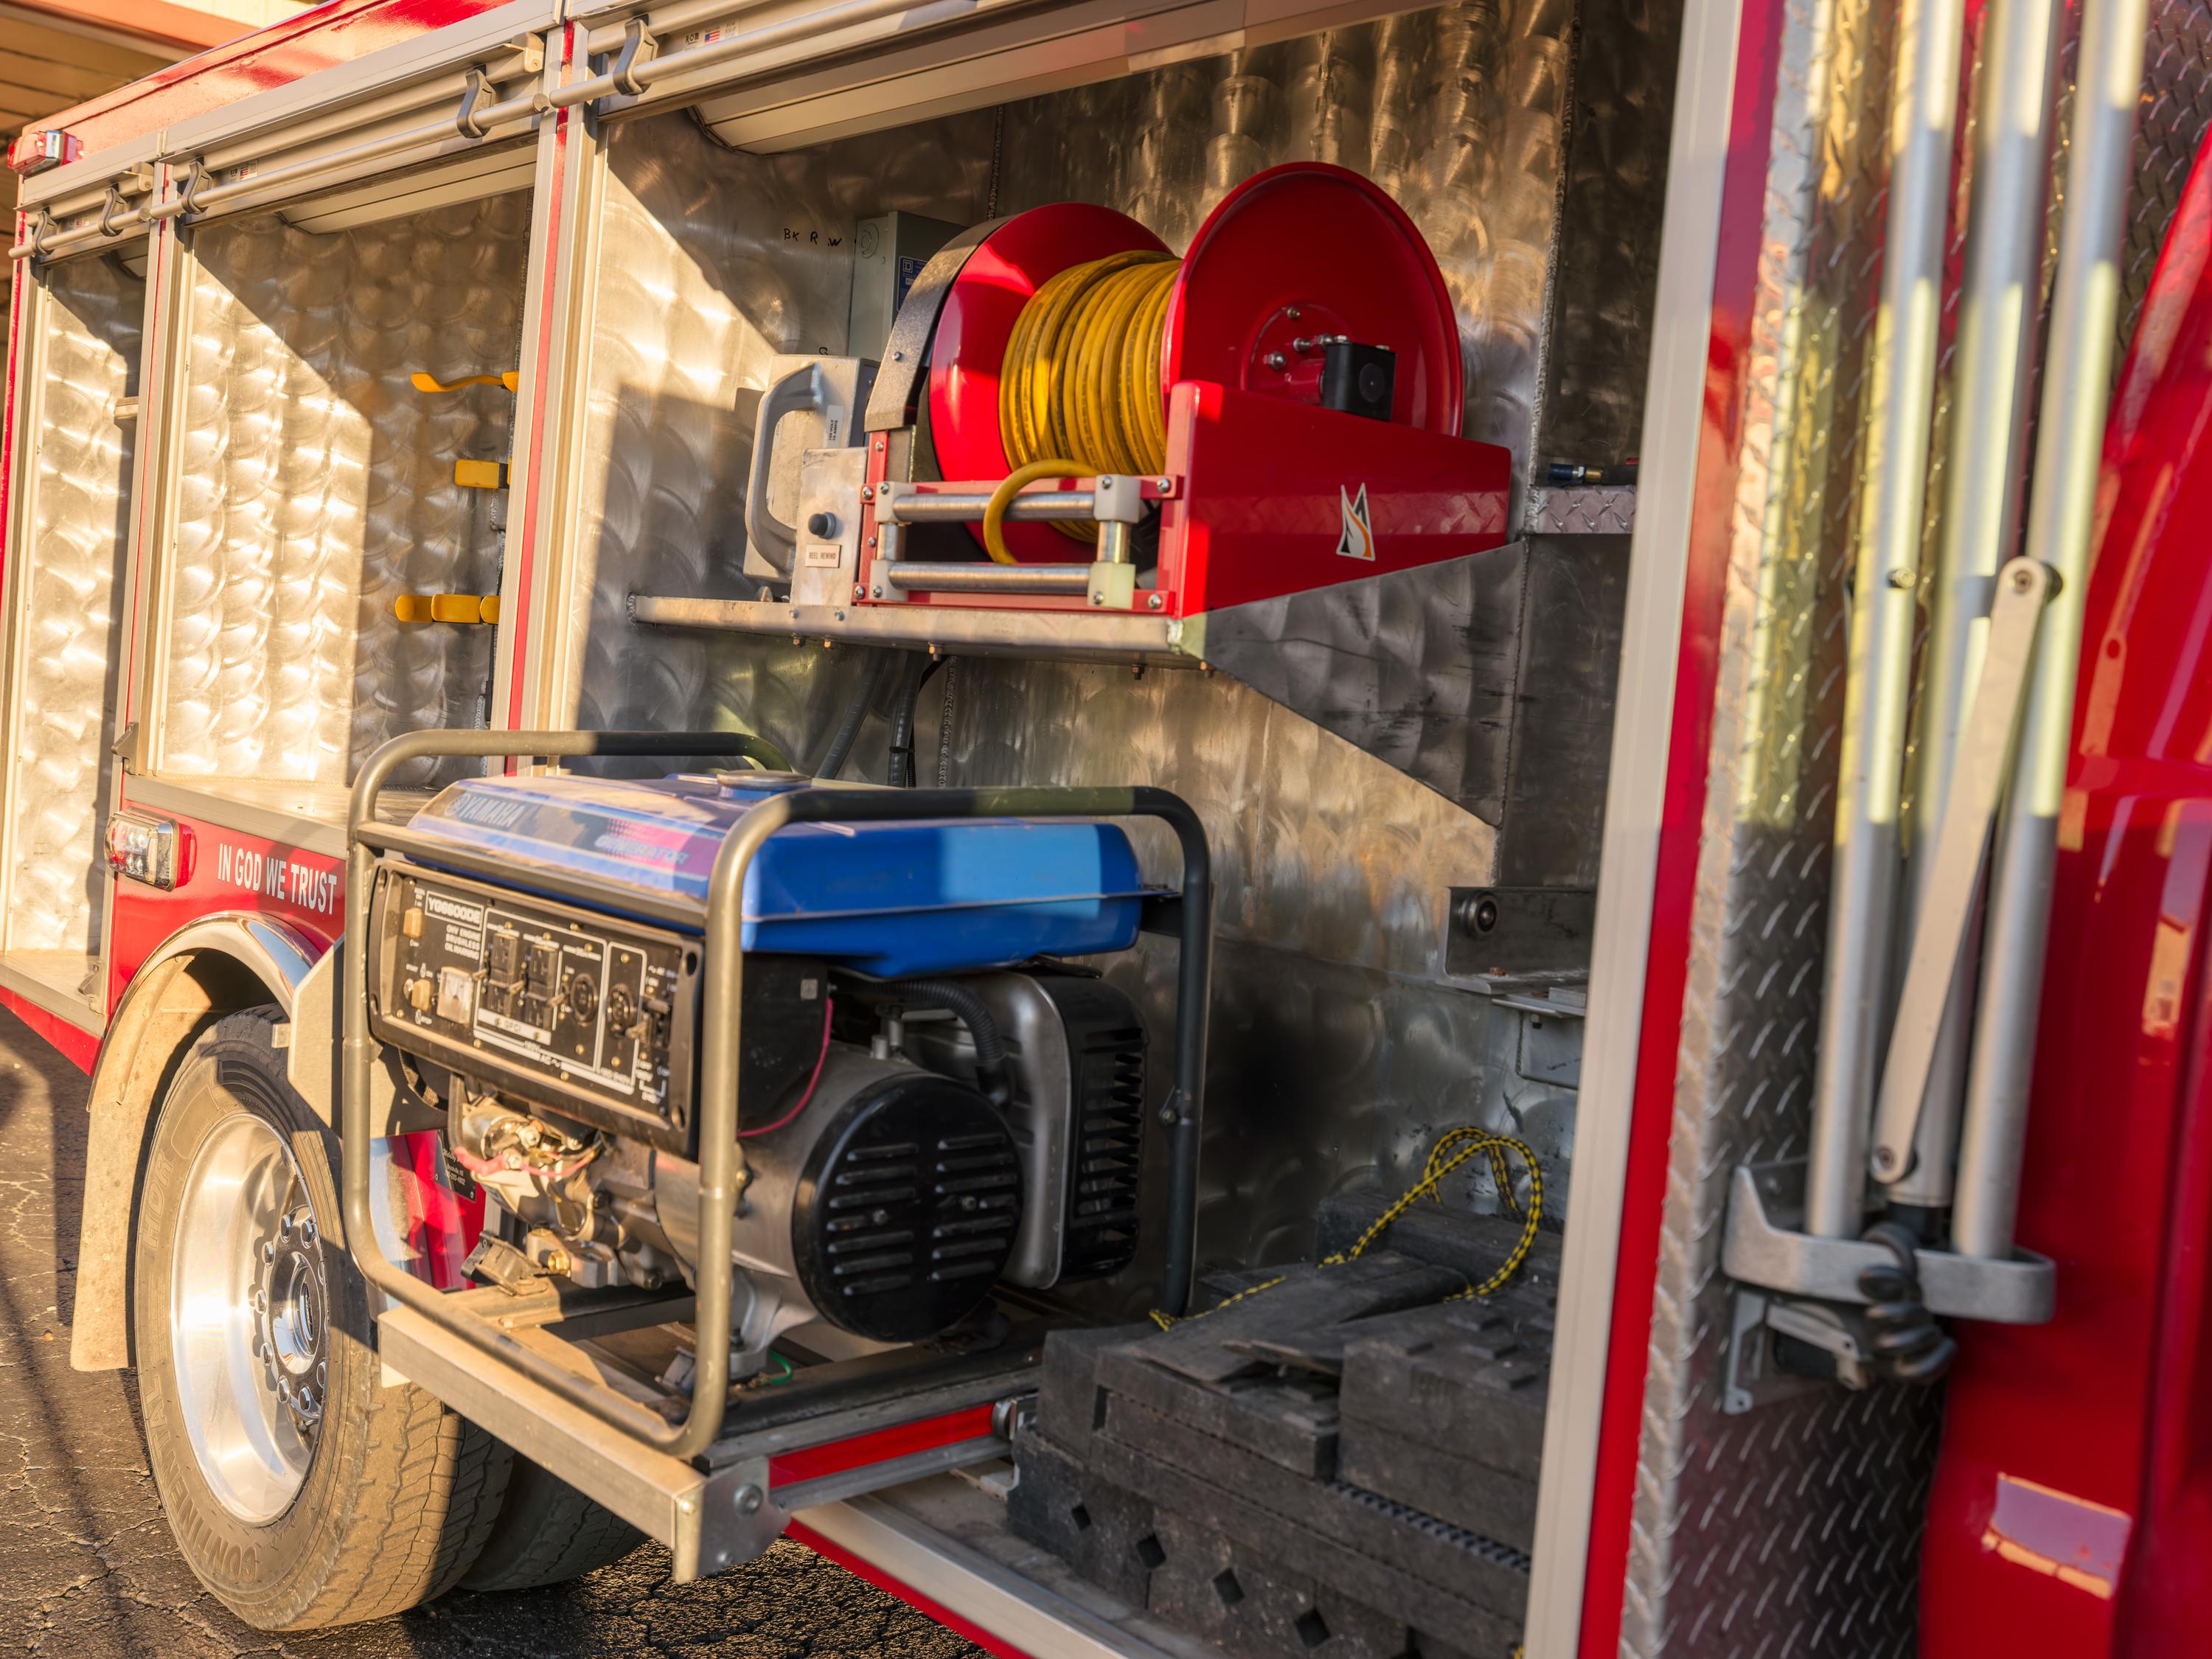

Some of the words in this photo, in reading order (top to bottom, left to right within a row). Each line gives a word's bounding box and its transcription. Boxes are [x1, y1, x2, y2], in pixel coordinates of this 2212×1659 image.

[809, 552, 818, 560] REEL
[820, 552, 836, 560] REWIND
[459, 794, 525, 827] YAMAHA
[594, 834, 689, 865] GENERATOR
[218, 843, 232, 883] IN
[234, 848, 262, 891] GOD
[265, 856, 287, 900] WE
[291, 863, 338, 915] TRUST
[428, 897, 481, 925] YG6600DE
[142, 1150, 173, 1251] HDR
[146, 1374, 257, 1584] CONTINENTAL
